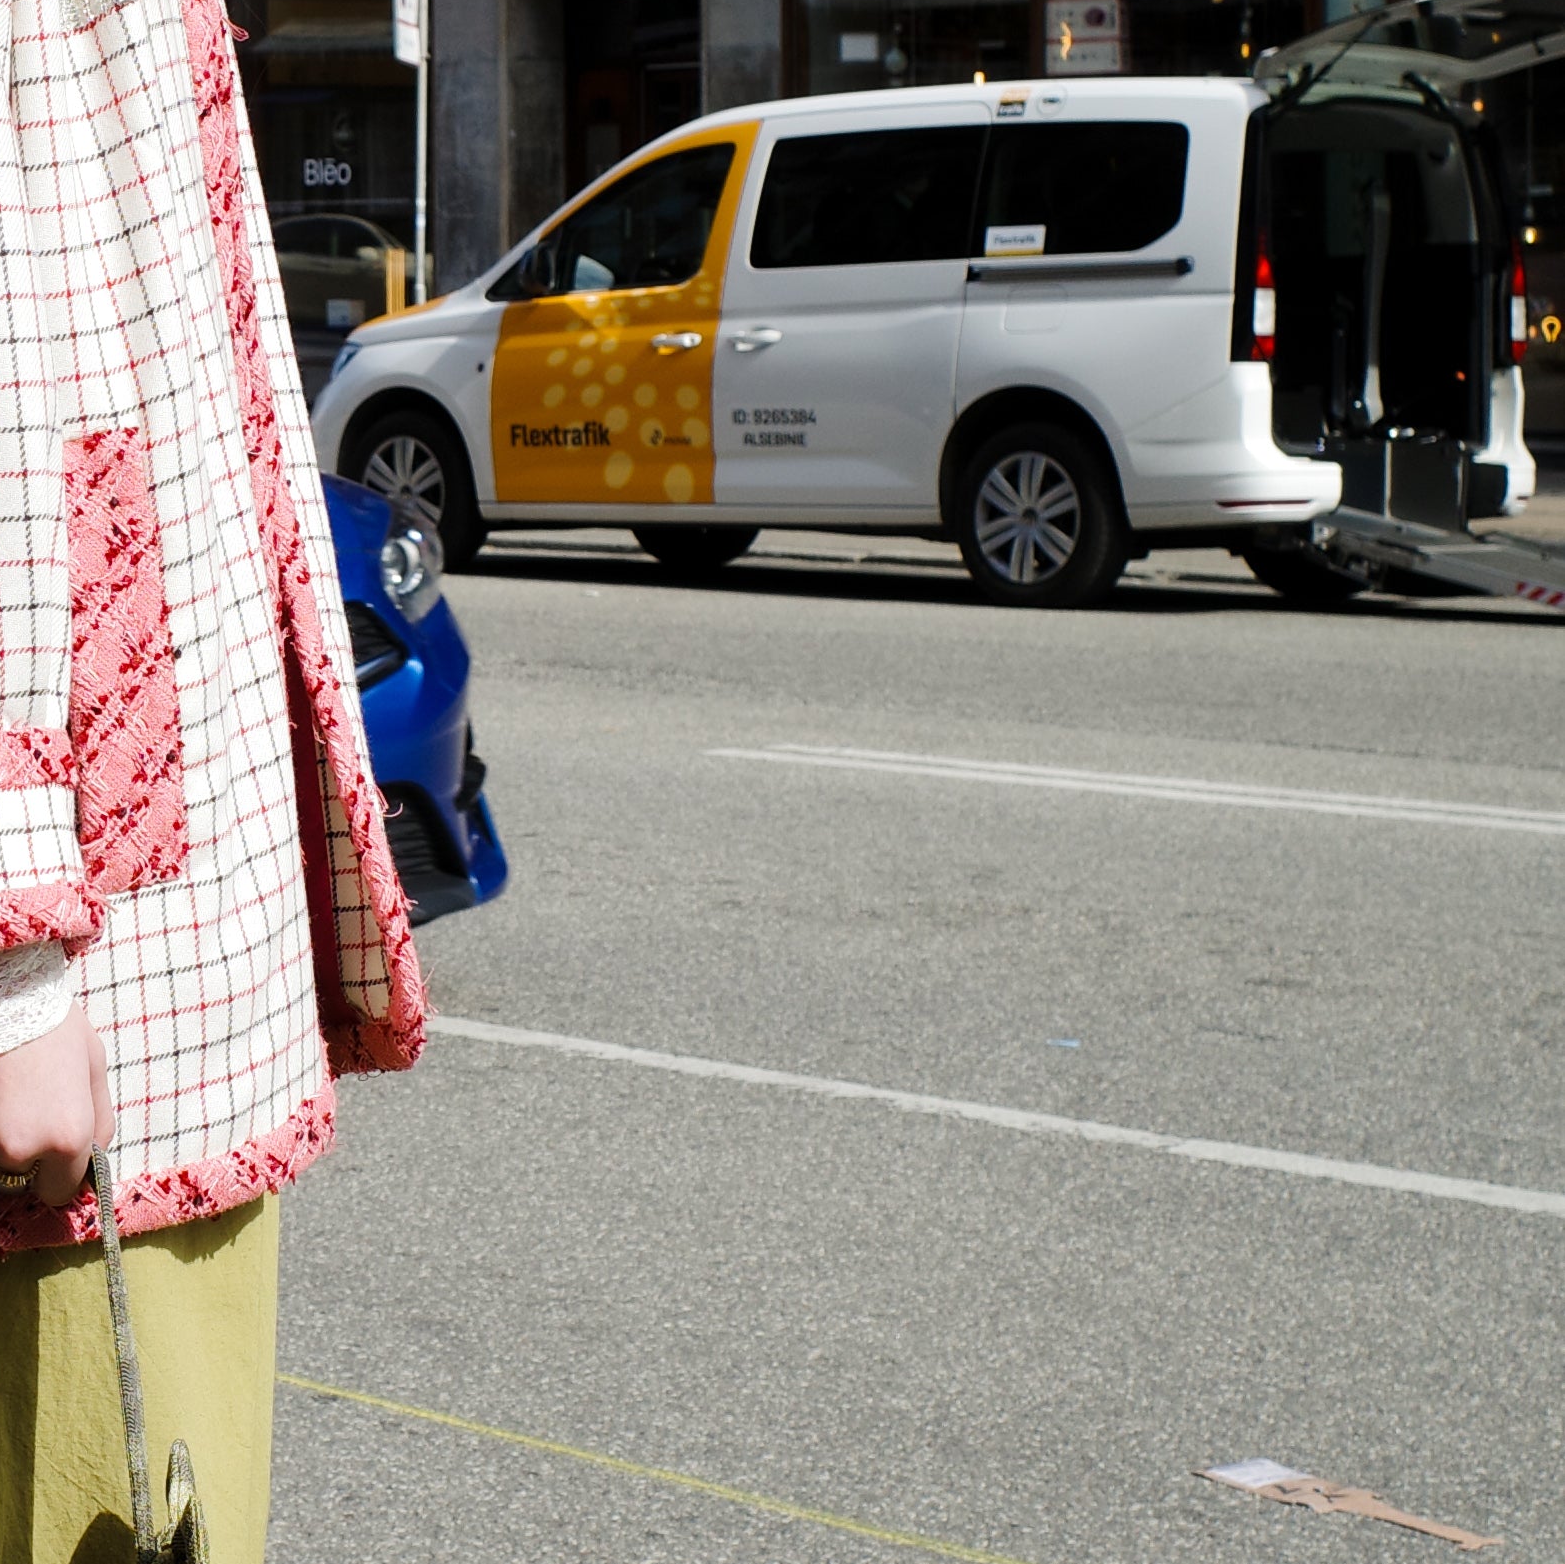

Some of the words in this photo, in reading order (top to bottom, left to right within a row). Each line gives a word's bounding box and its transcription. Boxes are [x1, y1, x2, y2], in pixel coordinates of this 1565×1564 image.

[303, 158, 352, 186] Blēo
[733, 409, 750, 425] ID:
[511, 421, 611, 448] Flextrafik
